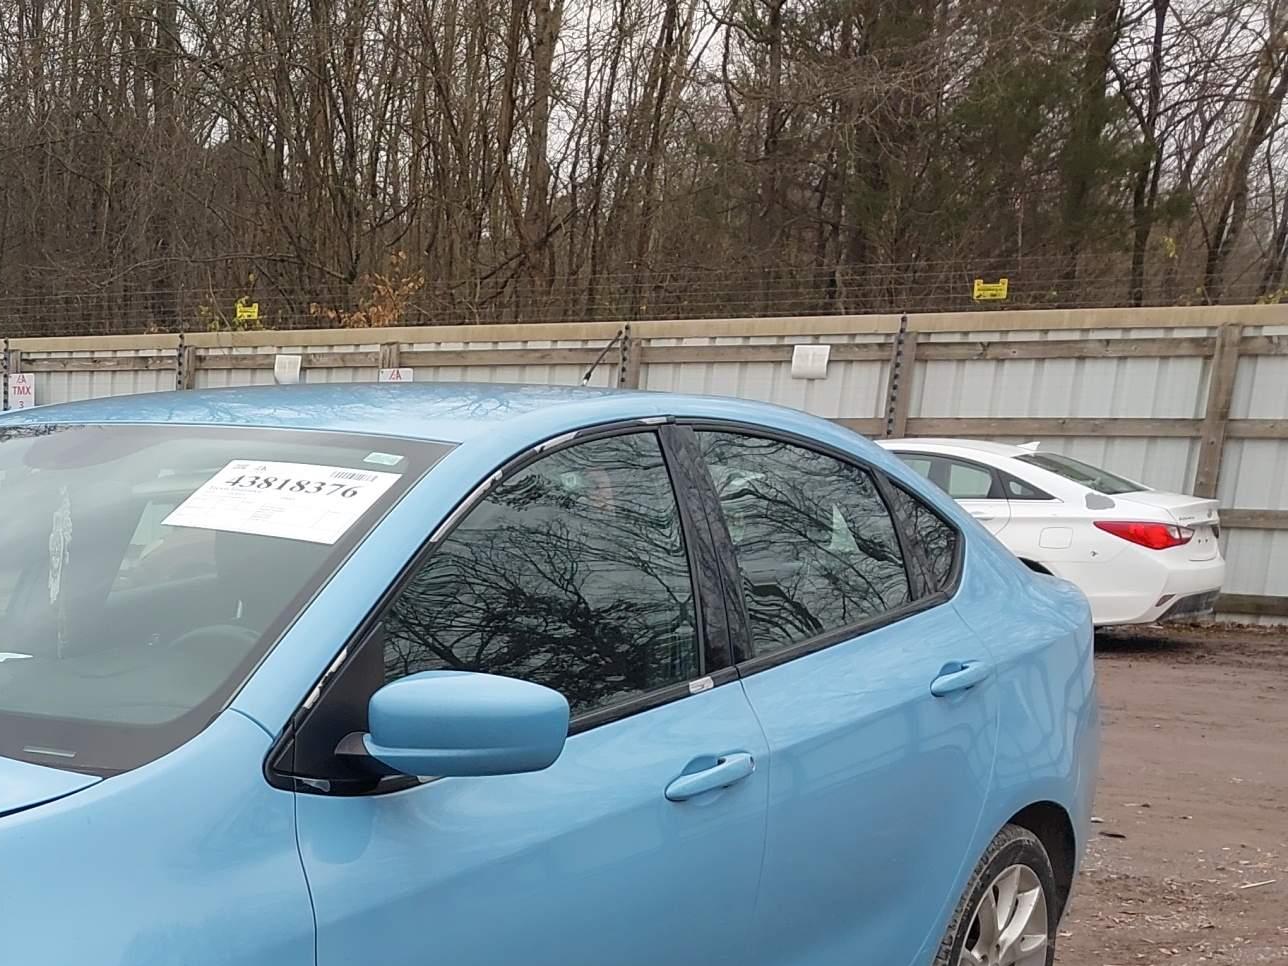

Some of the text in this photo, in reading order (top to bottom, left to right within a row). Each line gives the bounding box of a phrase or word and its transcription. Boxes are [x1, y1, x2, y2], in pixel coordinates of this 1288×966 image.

[12, 385, 32, 396] TMX
[18, 400, 25, 409] 3
[224, 474, 359, 498] 43818376
